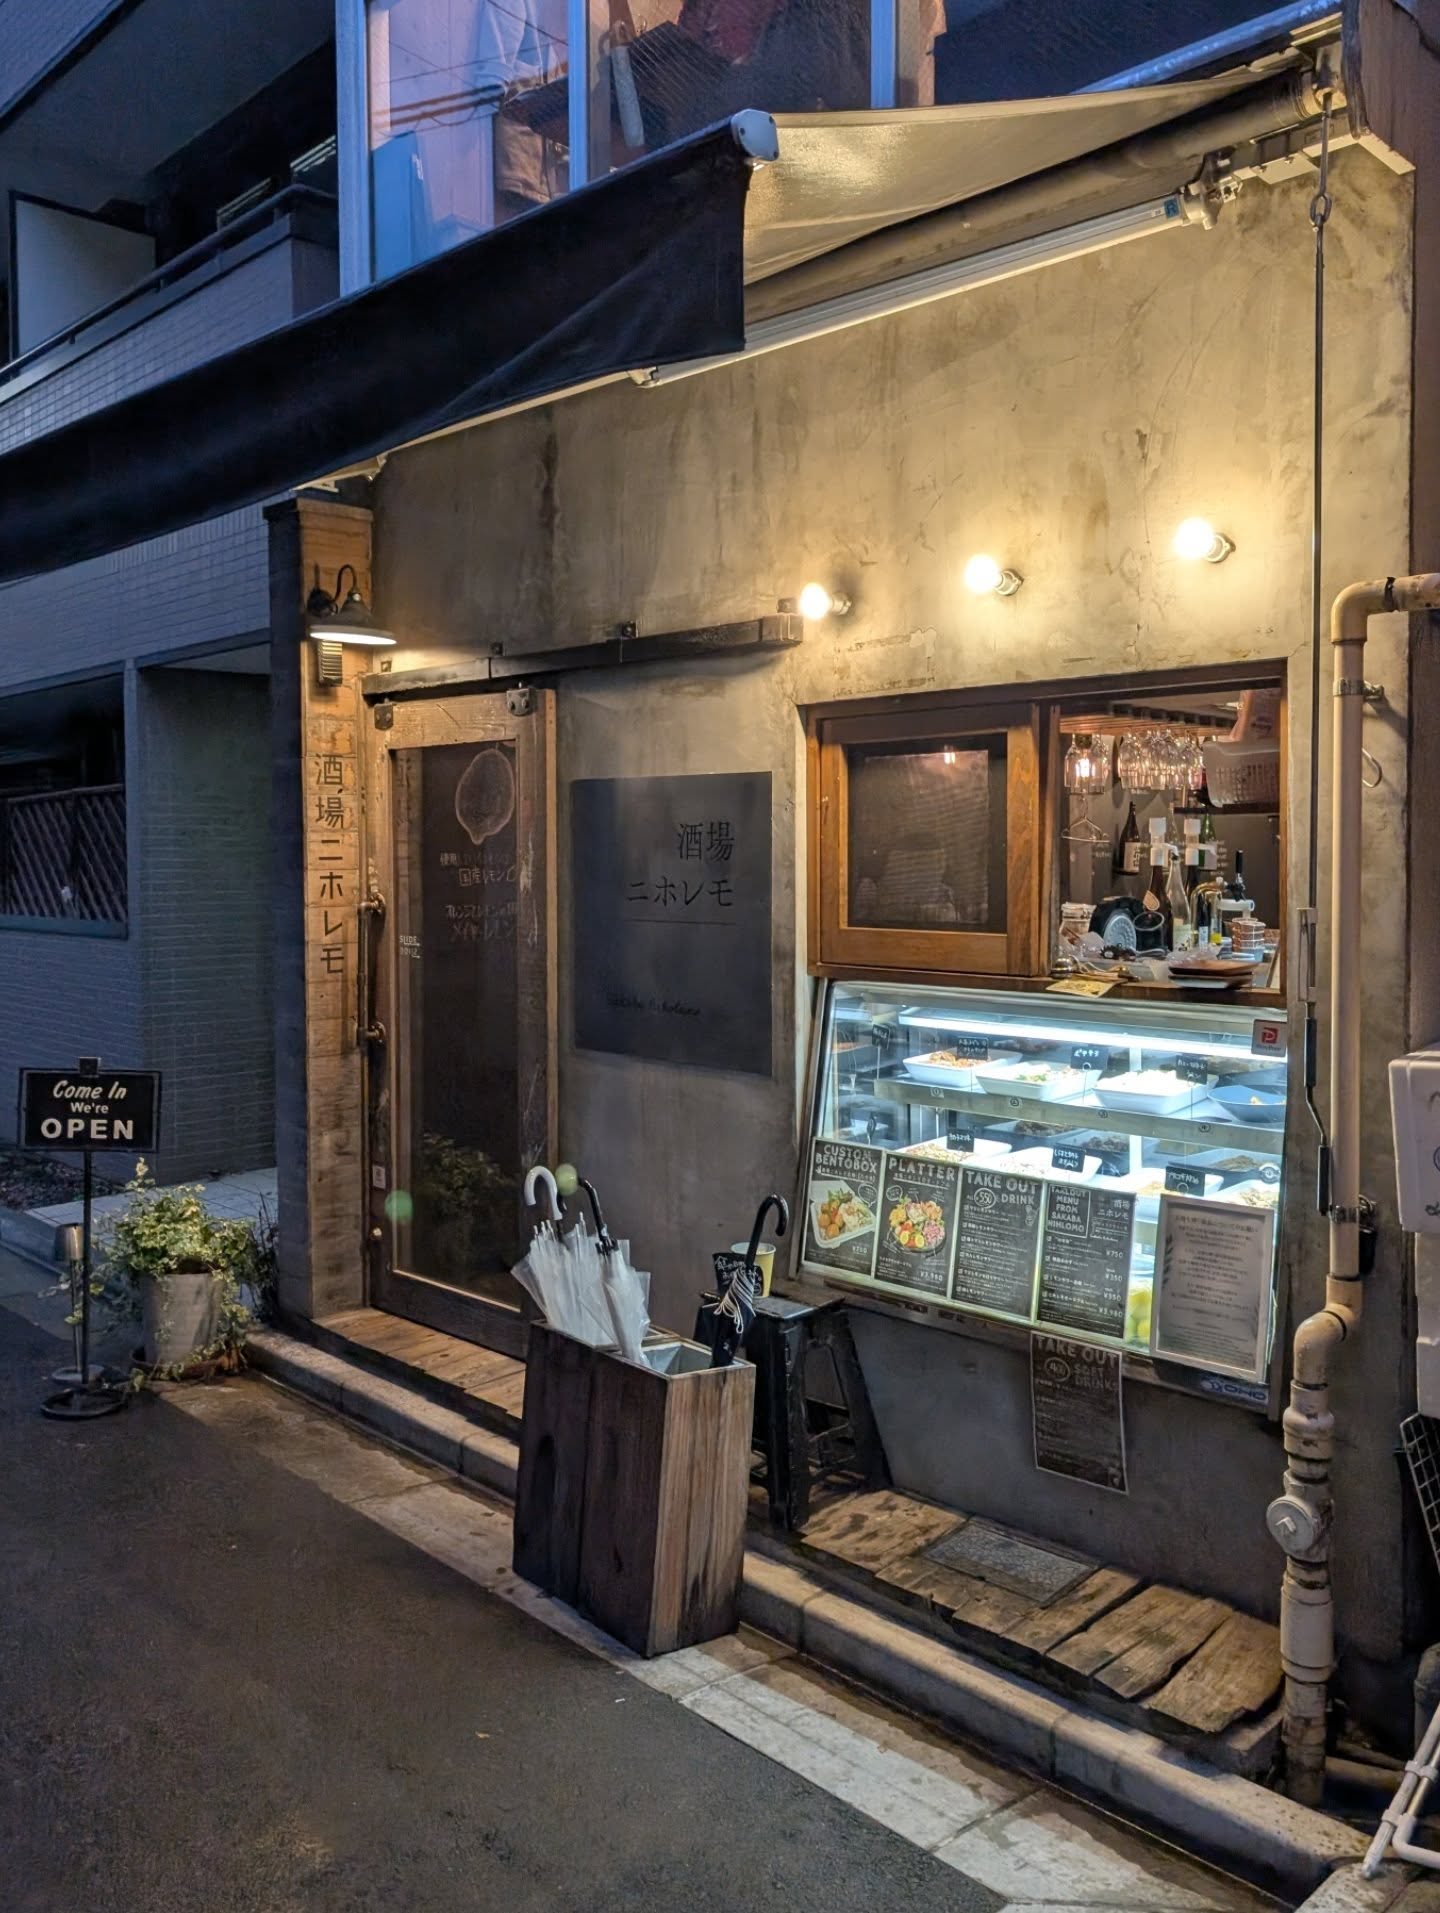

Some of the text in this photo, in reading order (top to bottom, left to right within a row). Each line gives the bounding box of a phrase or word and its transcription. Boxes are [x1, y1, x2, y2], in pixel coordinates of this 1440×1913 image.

[677, 821, 735, 862] 酒場
[314, 753, 345, 975] 酒場ニホレモ
[626, 875, 735, 908] ニホレモ
[53, 1080, 127, 1099] Come In
[70, 1102, 109, 1114] We're
[40, 1118, 134, 1140] OPEN
[816, 1152, 877, 1174] BENTOBOX
[888, 1157, 955, 1182] PLATTER
[965, 1170, 1002, 1189] TAKE
[1006, 1177, 1039, 1195] OUT
[1001, 1193, 1035, 1205] DRINK
[1055, 1203, 1078, 1214] FROM
[1056, 1195, 1080, 1206] MENU
[1051, 1212, 1082, 1223] SAKABA
[1034, 1335, 1118, 1369] TAKE OUT
